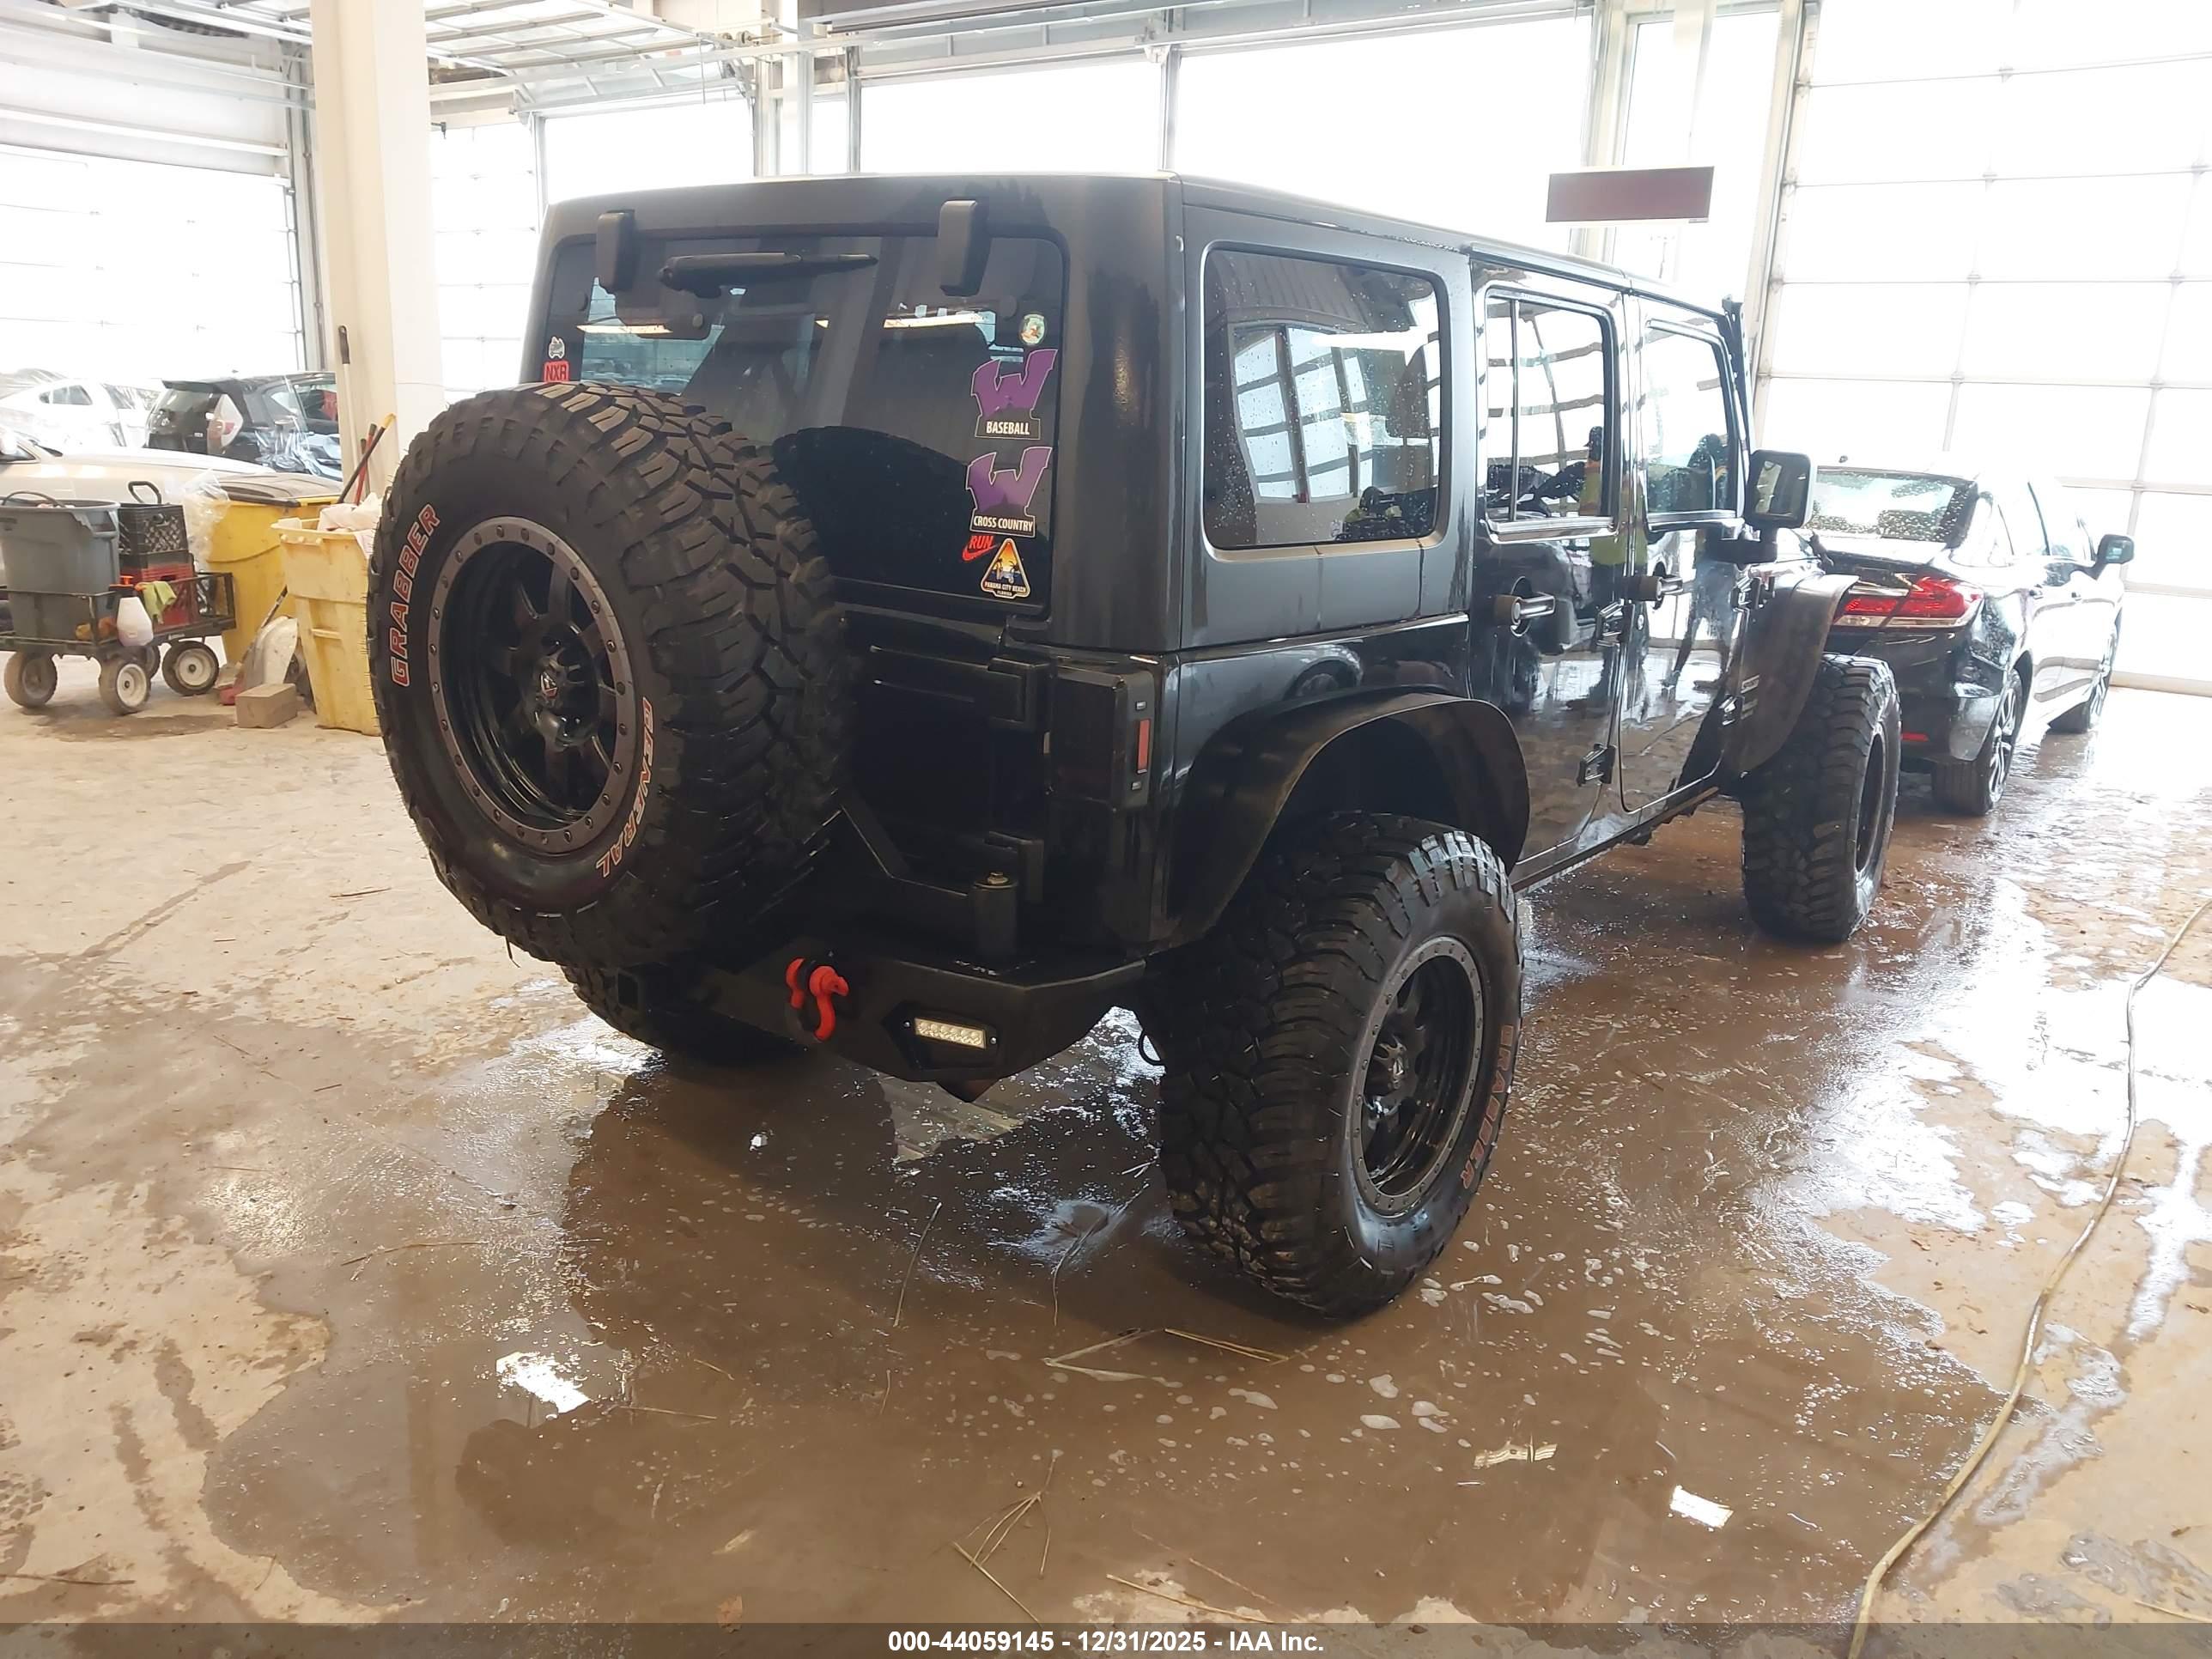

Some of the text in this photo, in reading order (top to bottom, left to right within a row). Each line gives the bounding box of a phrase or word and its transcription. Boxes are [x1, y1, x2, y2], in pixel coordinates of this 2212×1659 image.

[986, 421, 1030, 435] BASEBALL
[973, 515, 1034, 532] CROSS COUNTRY
[969, 535, 994, 550] RUN
[389, 503, 441, 687] GRABBER
[596, 696, 653, 878] GENERAL
